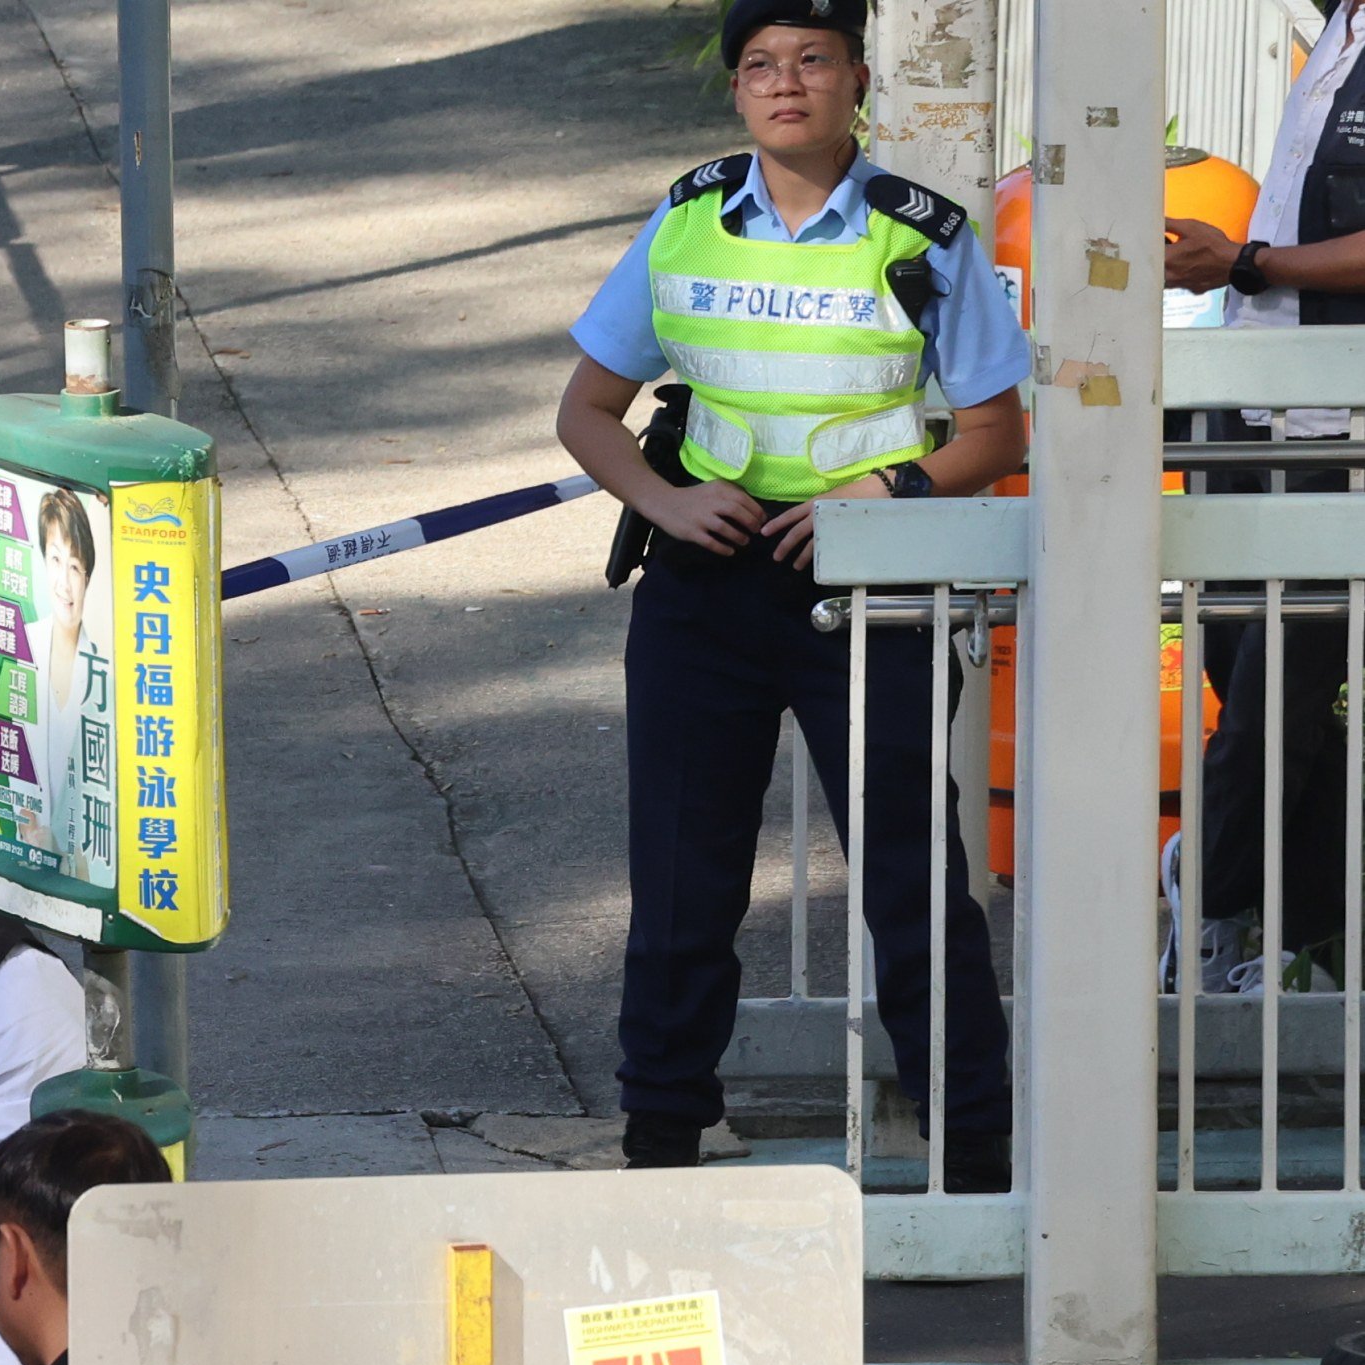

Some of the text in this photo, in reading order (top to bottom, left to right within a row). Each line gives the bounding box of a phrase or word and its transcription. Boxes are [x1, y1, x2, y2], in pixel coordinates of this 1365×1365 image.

[689, 281, 876, 322] 警 POLICE 察
[121, 525, 187, 540] STANFORD
[325, 530, 391, 563] 不得越過
[9, 669, 27, 694] 工程
[132, 560, 180, 912] 史丹福游泳學校
[78, 641, 111, 867] 方國珊
[26, 797, 43, 814] FONG
[582, 1312, 703, 1336] HIGHWAYS DEPARTMENT
